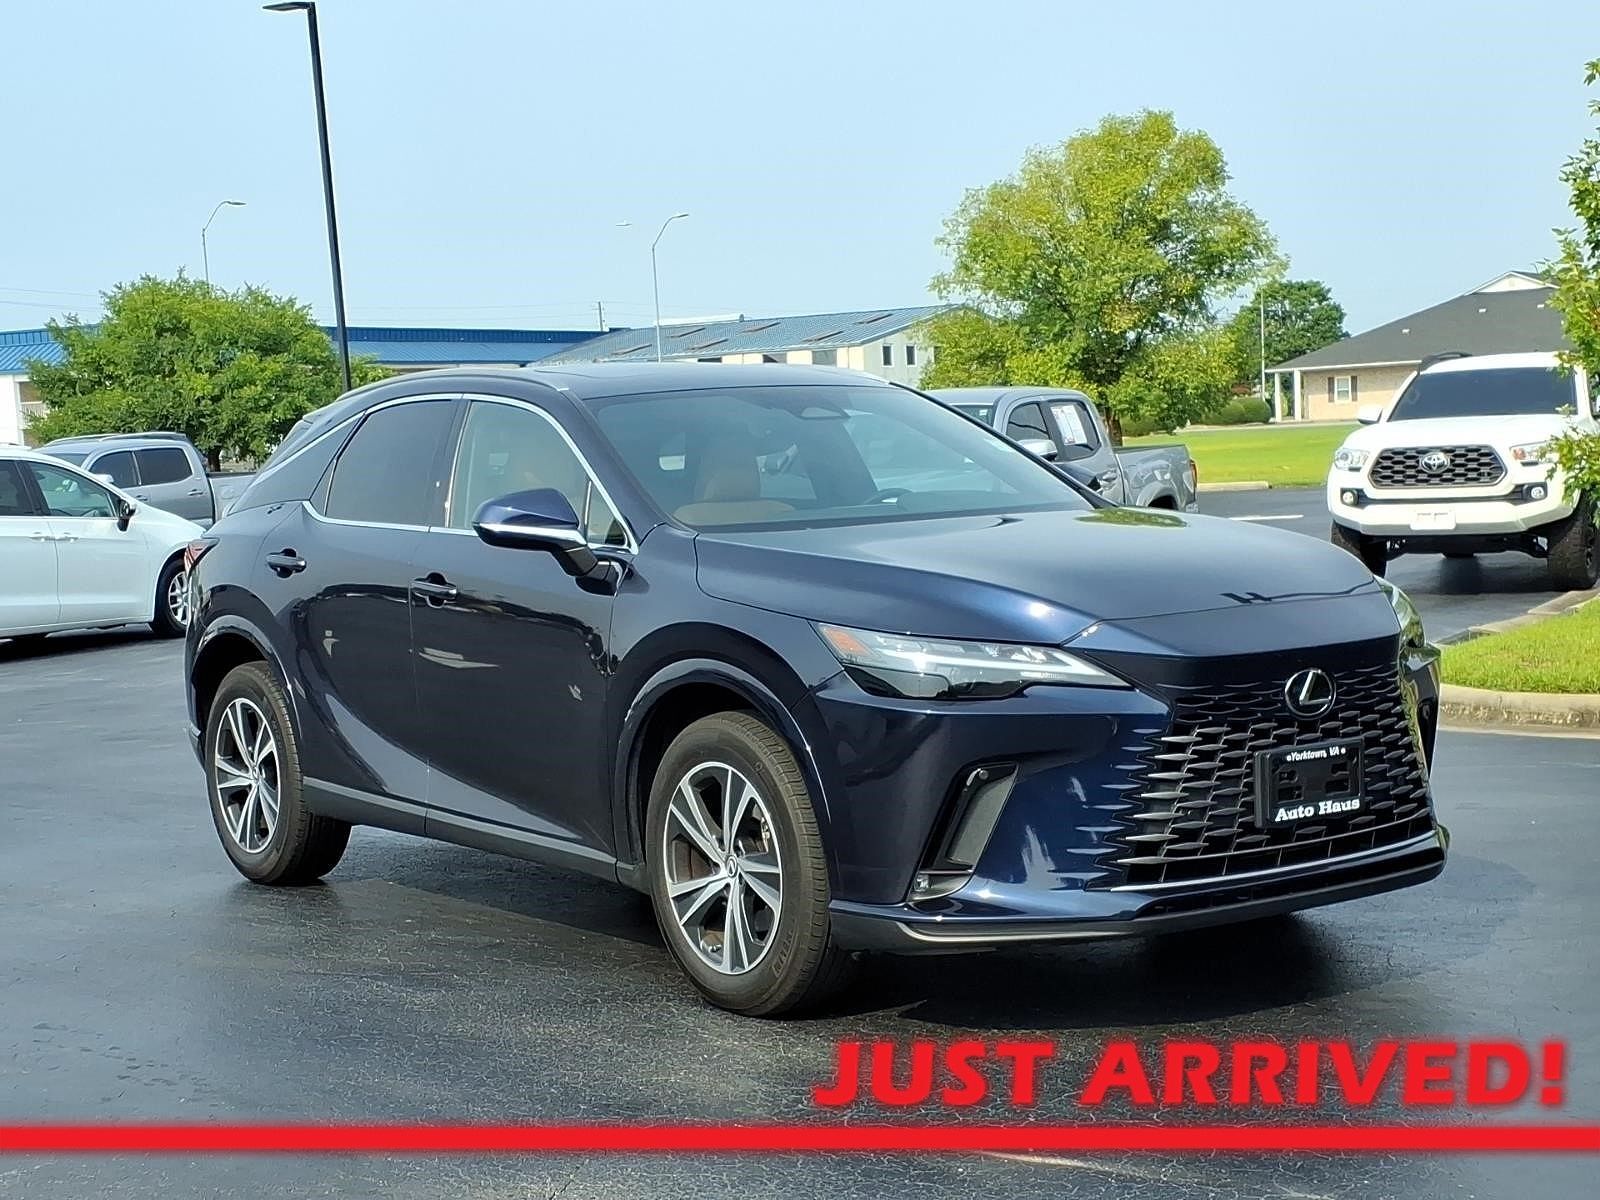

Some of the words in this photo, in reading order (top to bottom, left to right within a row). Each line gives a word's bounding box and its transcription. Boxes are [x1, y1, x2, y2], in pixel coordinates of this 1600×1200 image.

[1329, 746, 1339, 756] VA
[1274, 805, 1315, 822] Auto
[1318, 798, 1360, 815] Haus
